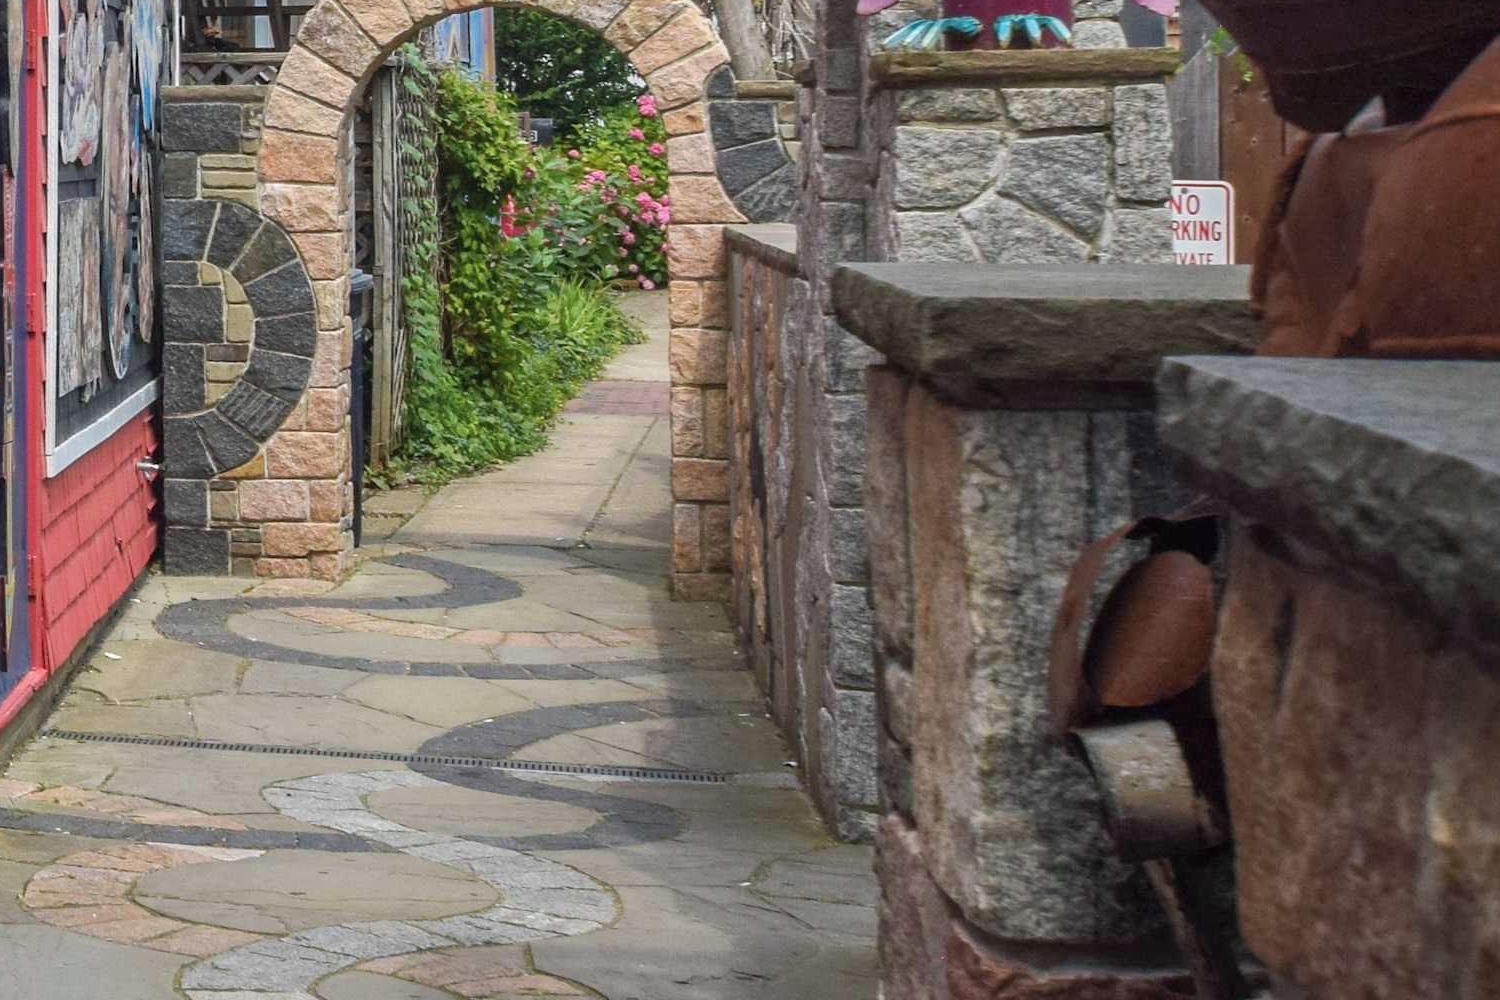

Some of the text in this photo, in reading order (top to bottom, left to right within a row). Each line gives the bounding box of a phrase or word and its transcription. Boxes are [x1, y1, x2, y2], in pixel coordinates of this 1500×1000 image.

[1169, 194, 1200, 215] NO
[1171, 220, 1221, 241] RKING
[1172, 252, 1214, 264] IVATE
